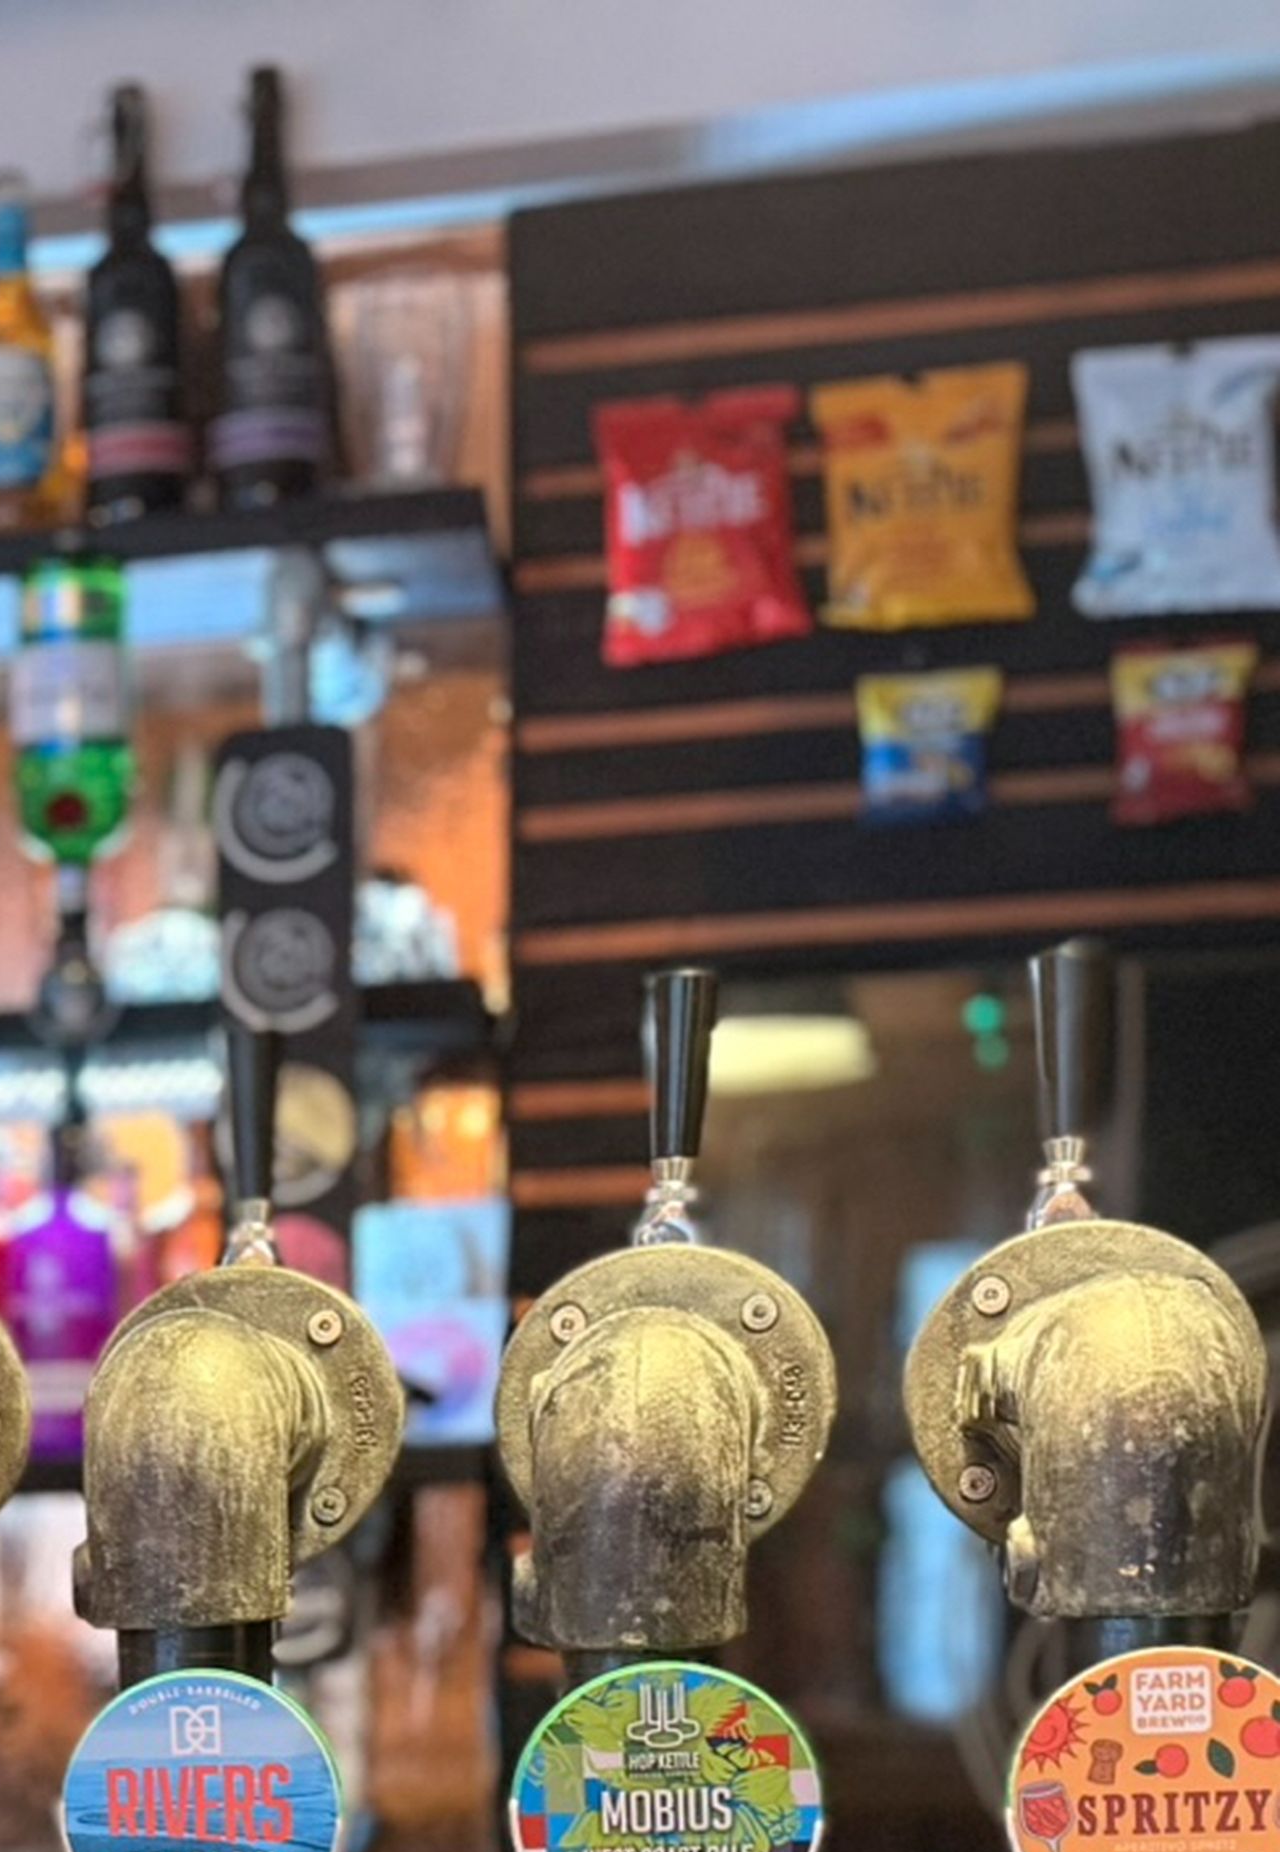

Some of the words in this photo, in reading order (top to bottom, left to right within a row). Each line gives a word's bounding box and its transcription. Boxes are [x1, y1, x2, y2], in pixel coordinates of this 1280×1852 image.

[1135, 1671, 1205, 1691] FARM
[1136, 1692, 1206, 1713] YARD
[658, 1751, 700, 1769] KETTLE
[106, 1763, 295, 1845] RIVERS
[600, 1786, 734, 1834] MOBIUS
[1077, 1789, 1272, 1836] SPRITZY
